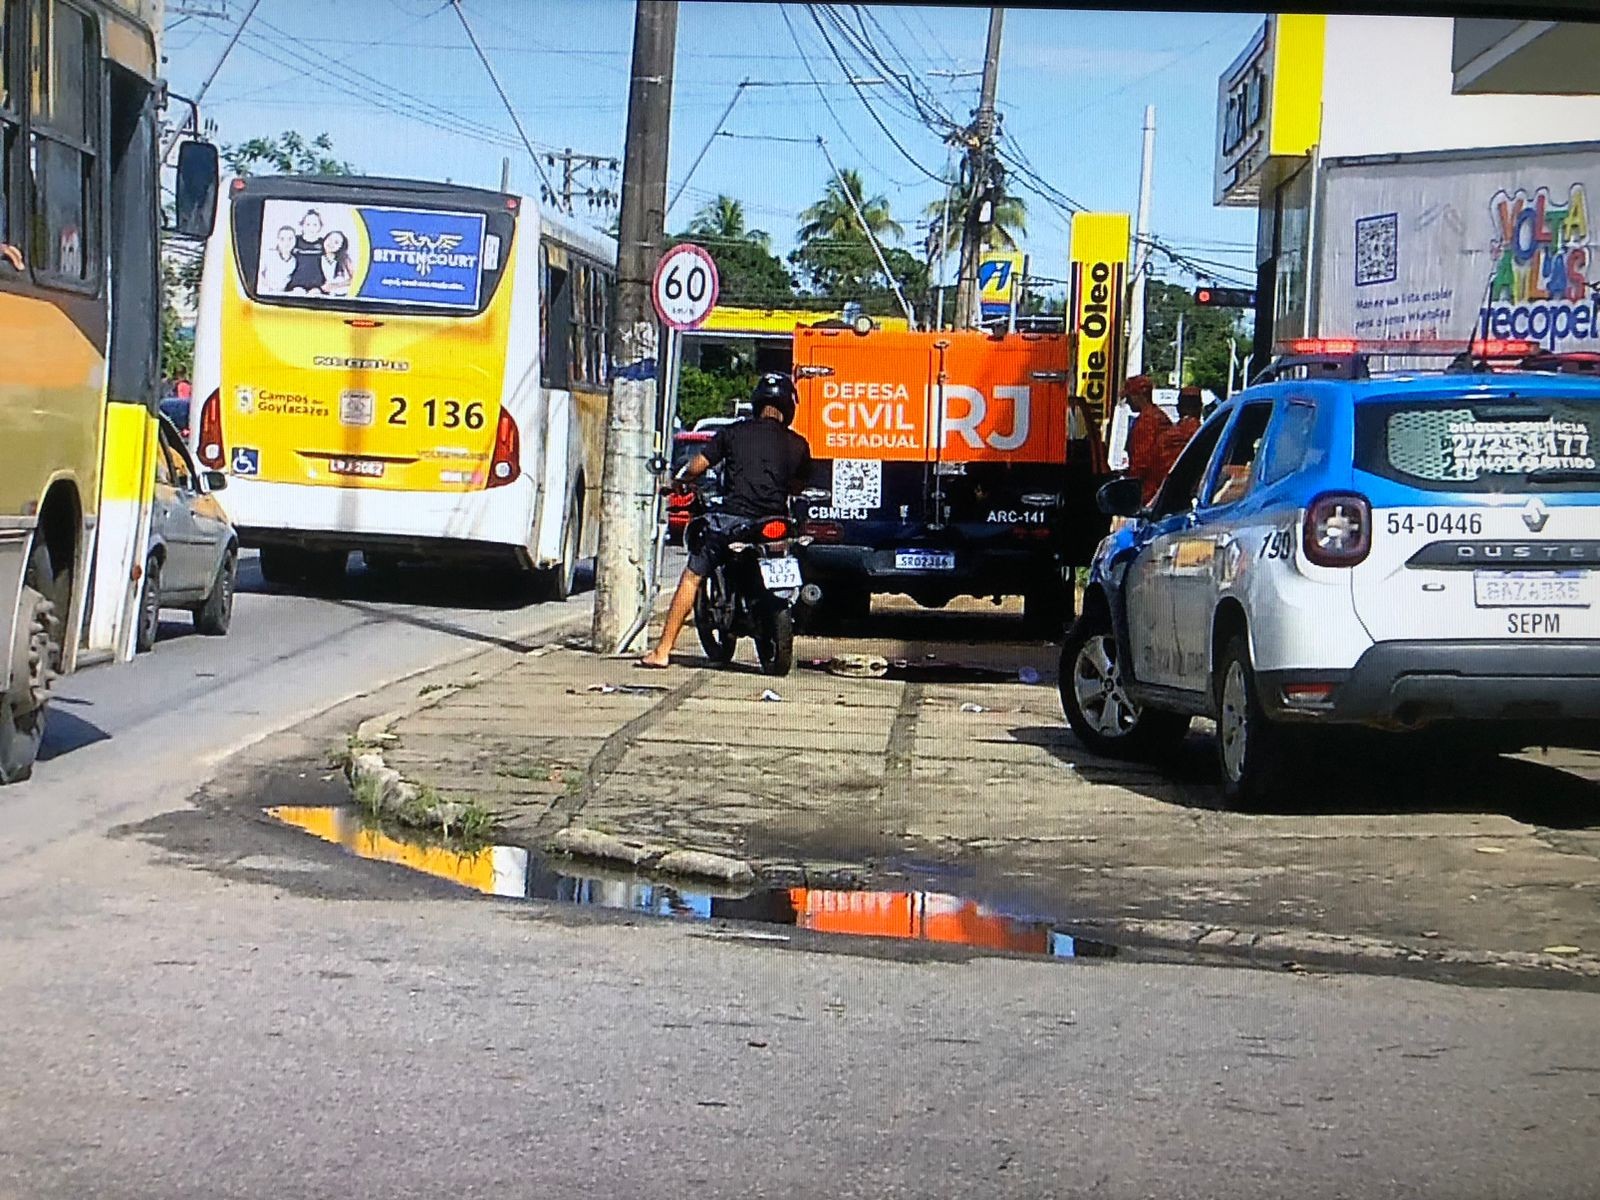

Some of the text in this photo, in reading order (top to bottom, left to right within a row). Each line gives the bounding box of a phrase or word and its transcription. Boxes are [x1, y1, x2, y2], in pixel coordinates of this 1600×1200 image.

[1497, 192, 1589, 260] VOLTA
[373, 248, 478, 269] BITTENCOURT
[665, 265, 706, 302] 60
[1080, 262, 1109, 338] Óleo
[259, 390, 308, 405] Campos
[823, 382, 909, 400] DEFESA
[258, 401, 329, 417] Goytacazes
[388, 397, 407, 425] 2
[423, 398, 484, 430] 136
[822, 384, 1031, 450] CIVIL RJ
[826, 433, 919, 449] ESTADUAL
[808, 506, 868, 519] CBMERJ
[987, 510, 1045, 523] ARC-141
[1387, 512, 1482, 534] 54-0446
[1259, 531, 1291, 559] 190
[1508, 613, 1560, 634] SEPM
